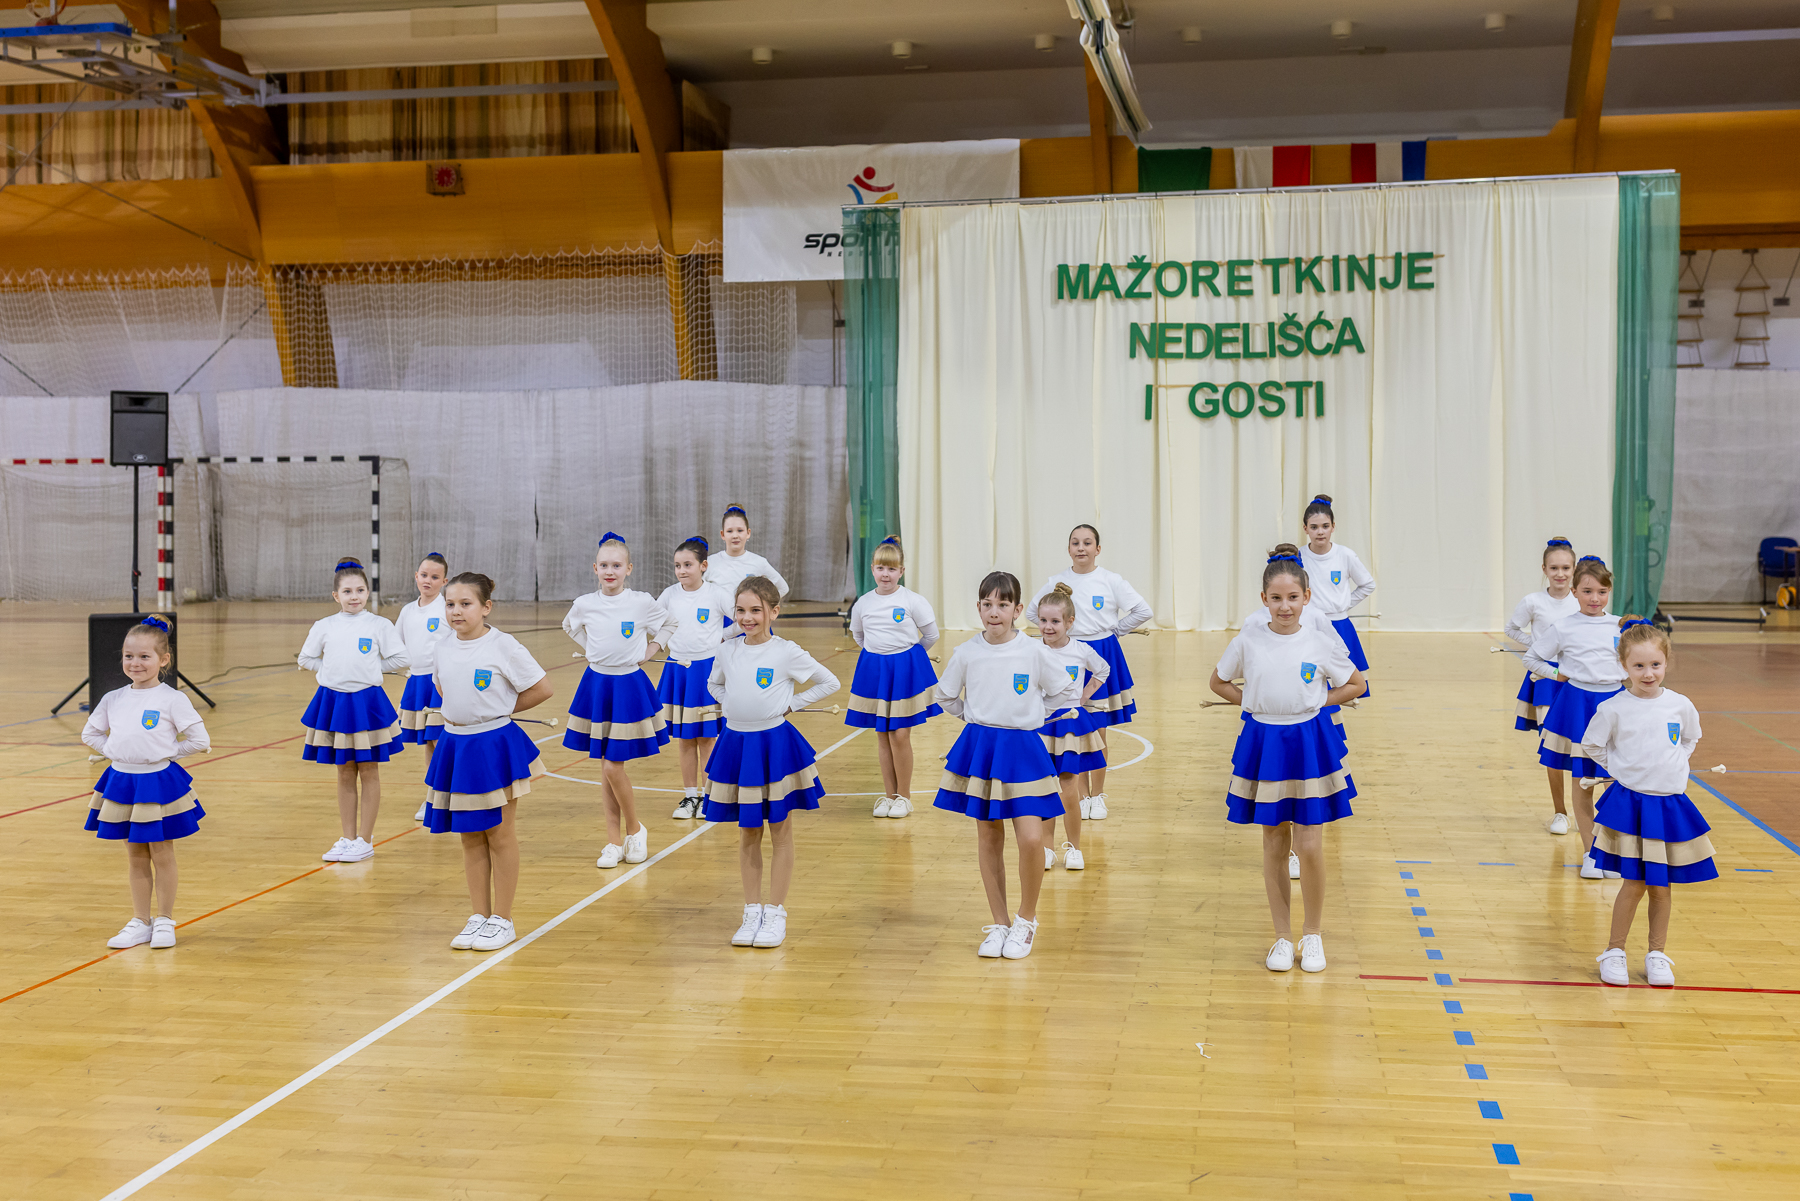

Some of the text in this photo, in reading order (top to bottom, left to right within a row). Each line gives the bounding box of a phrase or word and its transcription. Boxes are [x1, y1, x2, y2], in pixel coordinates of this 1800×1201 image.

[1057, 252, 1435, 300] MAŽORETKINJE
[1129, 311, 1365, 360] NEDELIŠĆA
[1144, 380, 1325, 420] I GOSTI
